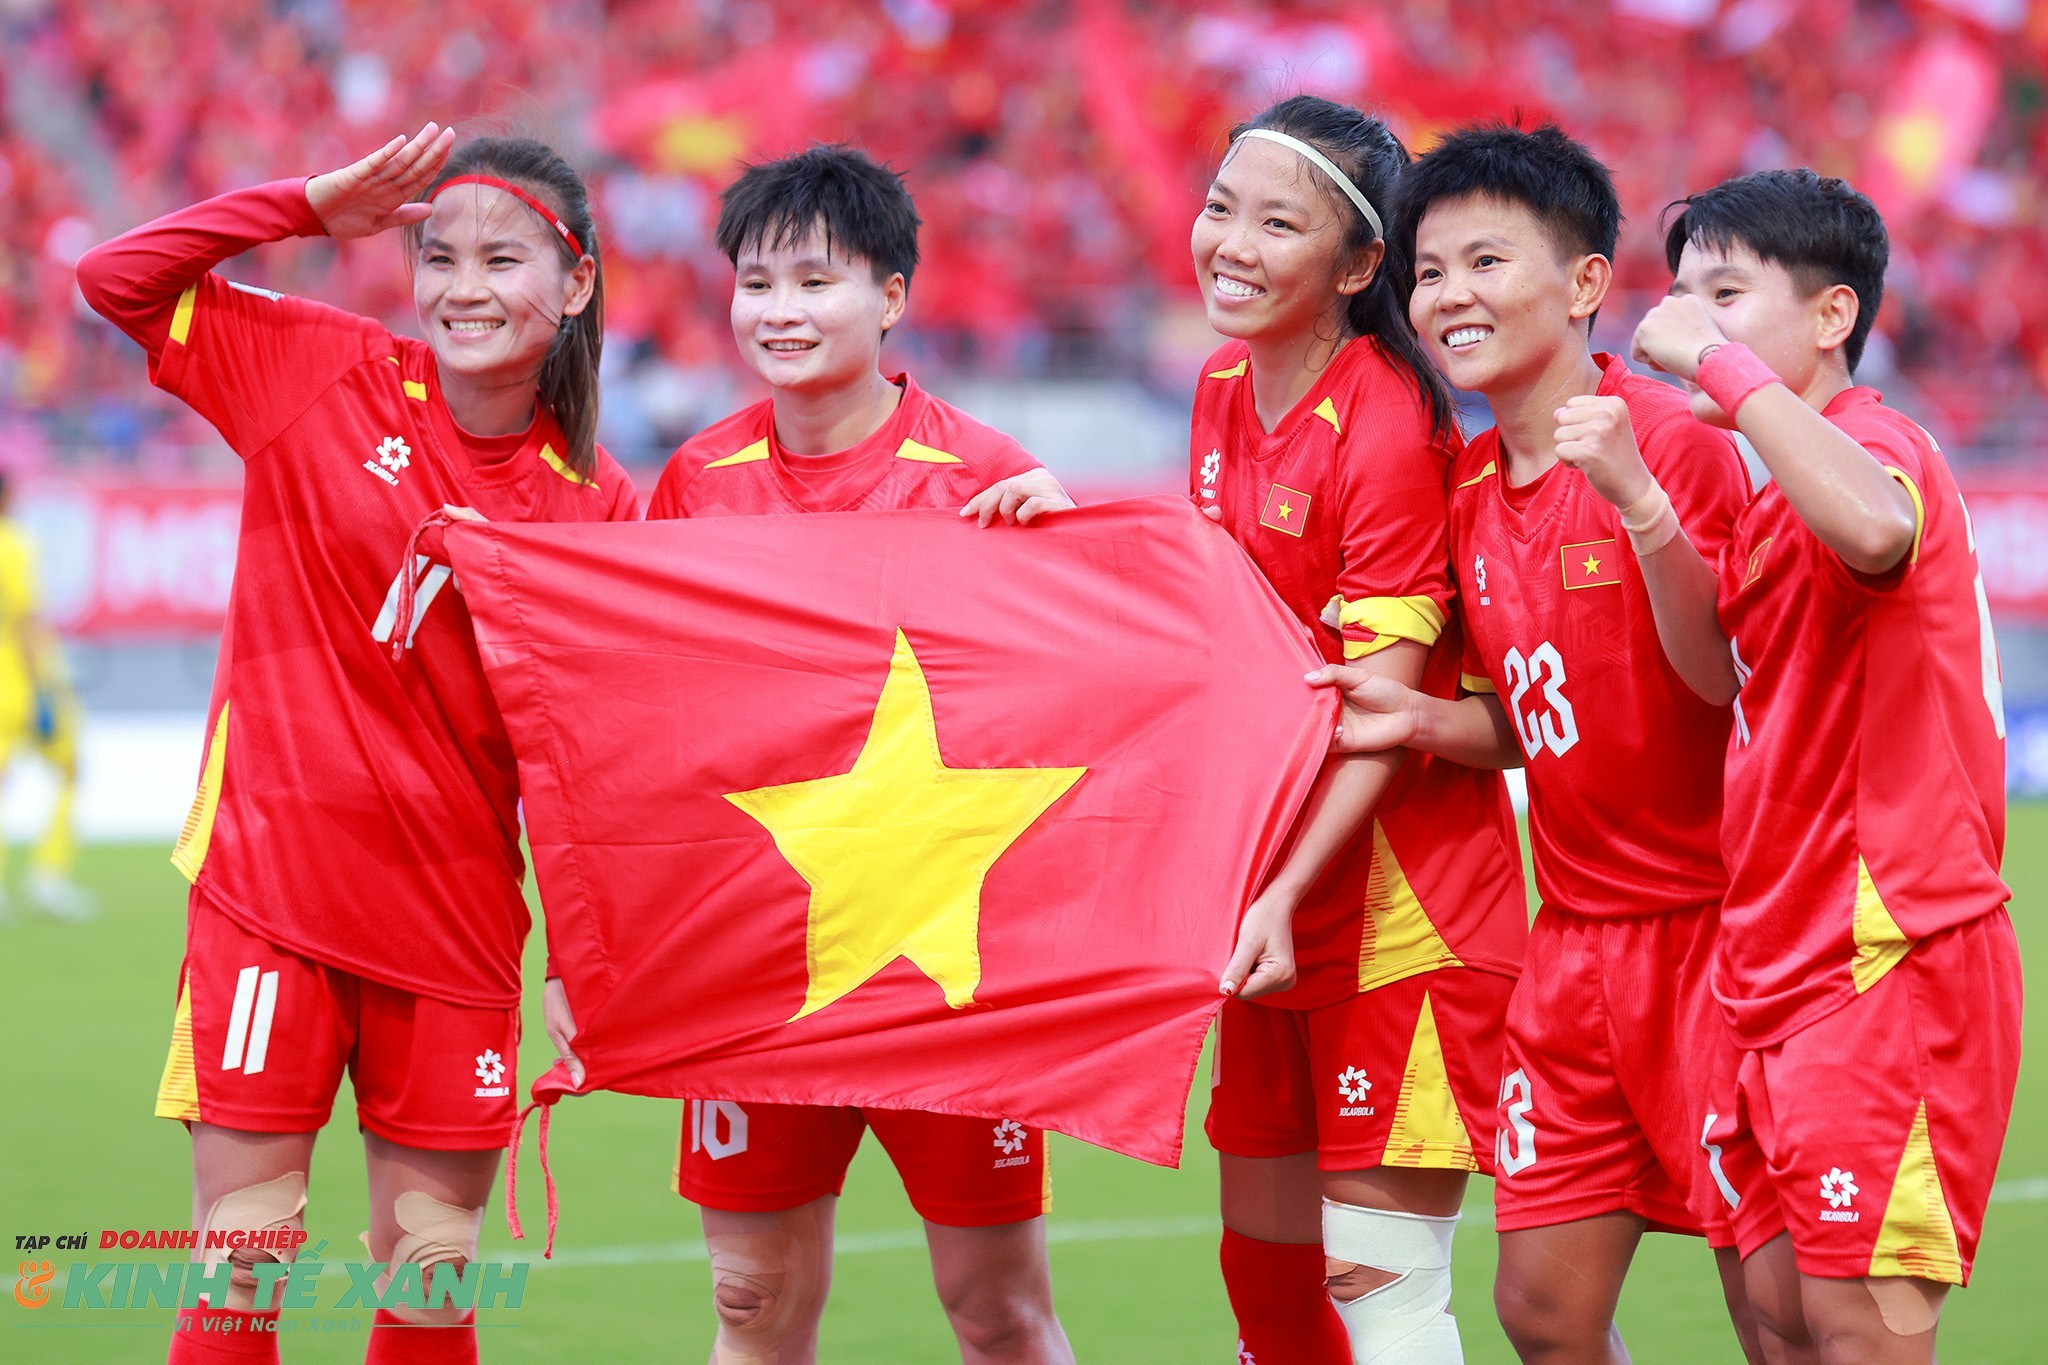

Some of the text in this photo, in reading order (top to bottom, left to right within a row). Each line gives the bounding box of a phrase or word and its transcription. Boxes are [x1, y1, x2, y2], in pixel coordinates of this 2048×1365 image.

[1503, 640, 1580, 761] 23
[221, 965, 279, 1075] 11
[1495, 1067, 1537, 1178] 3
